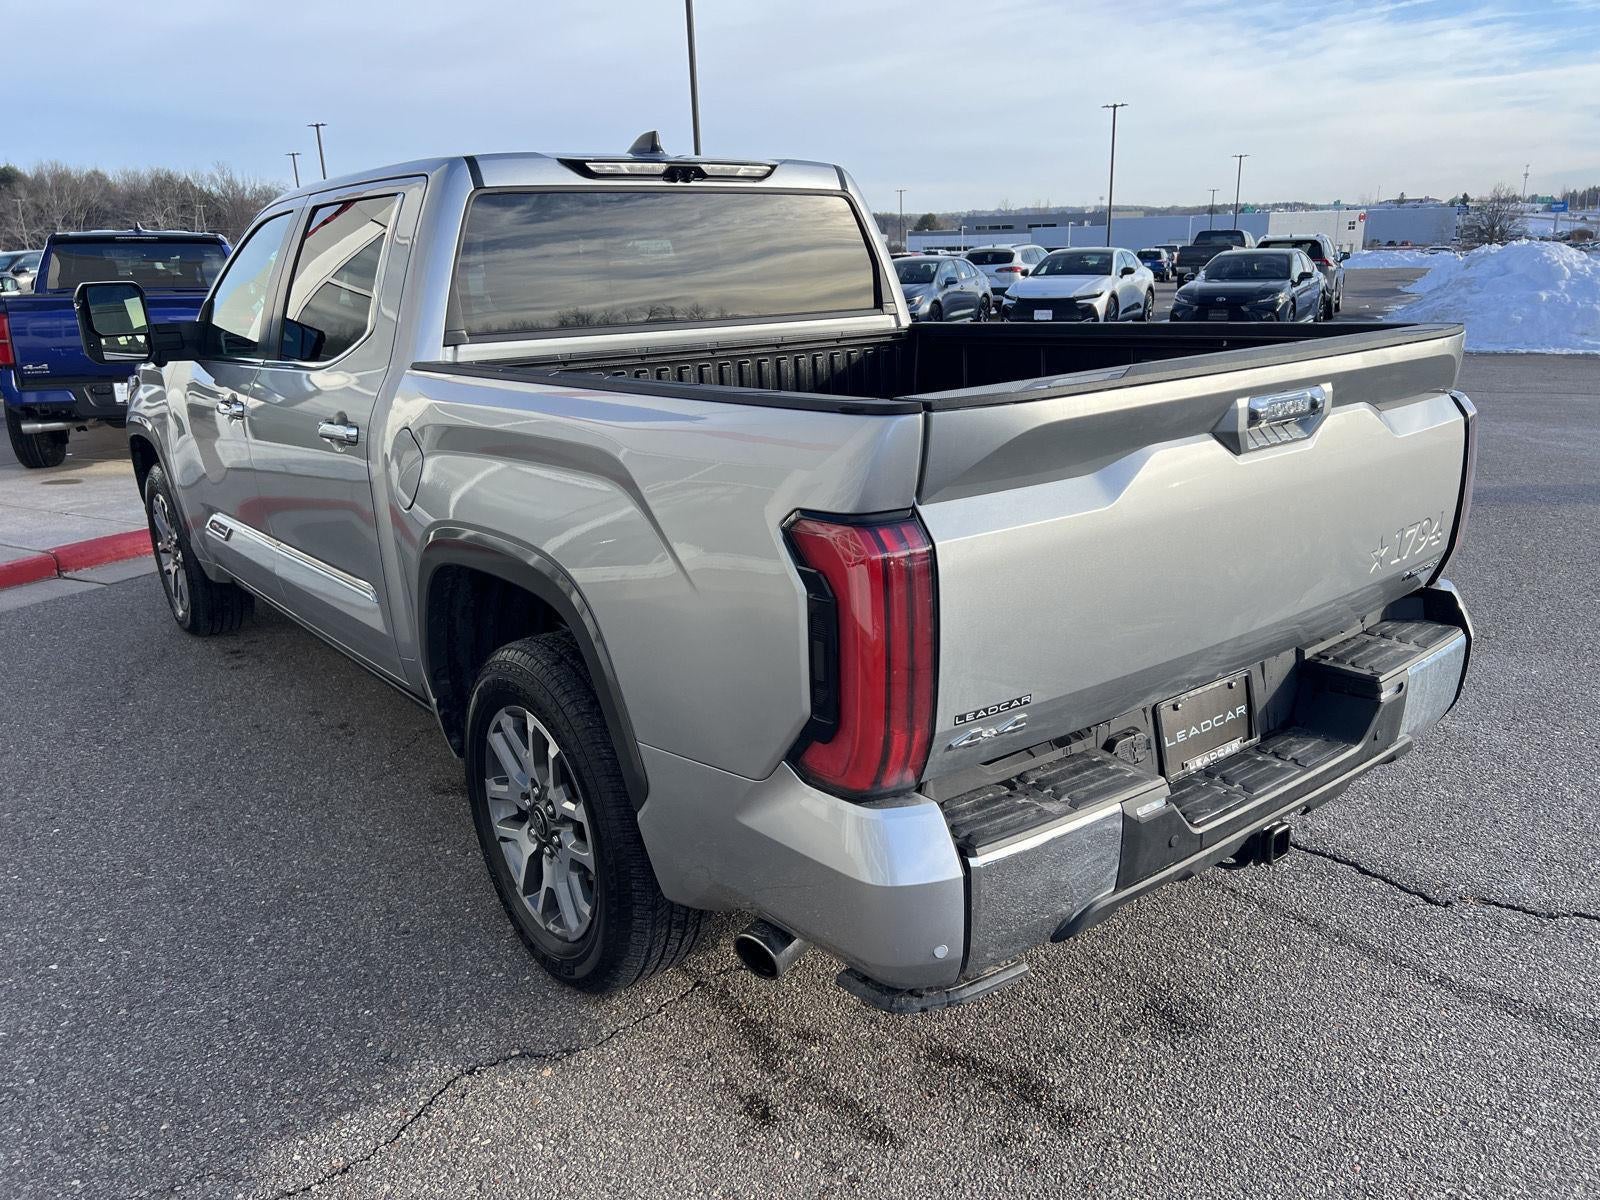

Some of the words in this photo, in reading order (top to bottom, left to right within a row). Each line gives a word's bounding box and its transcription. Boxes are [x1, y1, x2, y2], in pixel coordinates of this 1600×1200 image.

[1390, 511, 1444, 565] 1794
[955, 695, 1031, 725] LEADCAR
[1164, 705, 1247, 748] LEADCAR
[1188, 740, 1242, 770] LEADCAR
